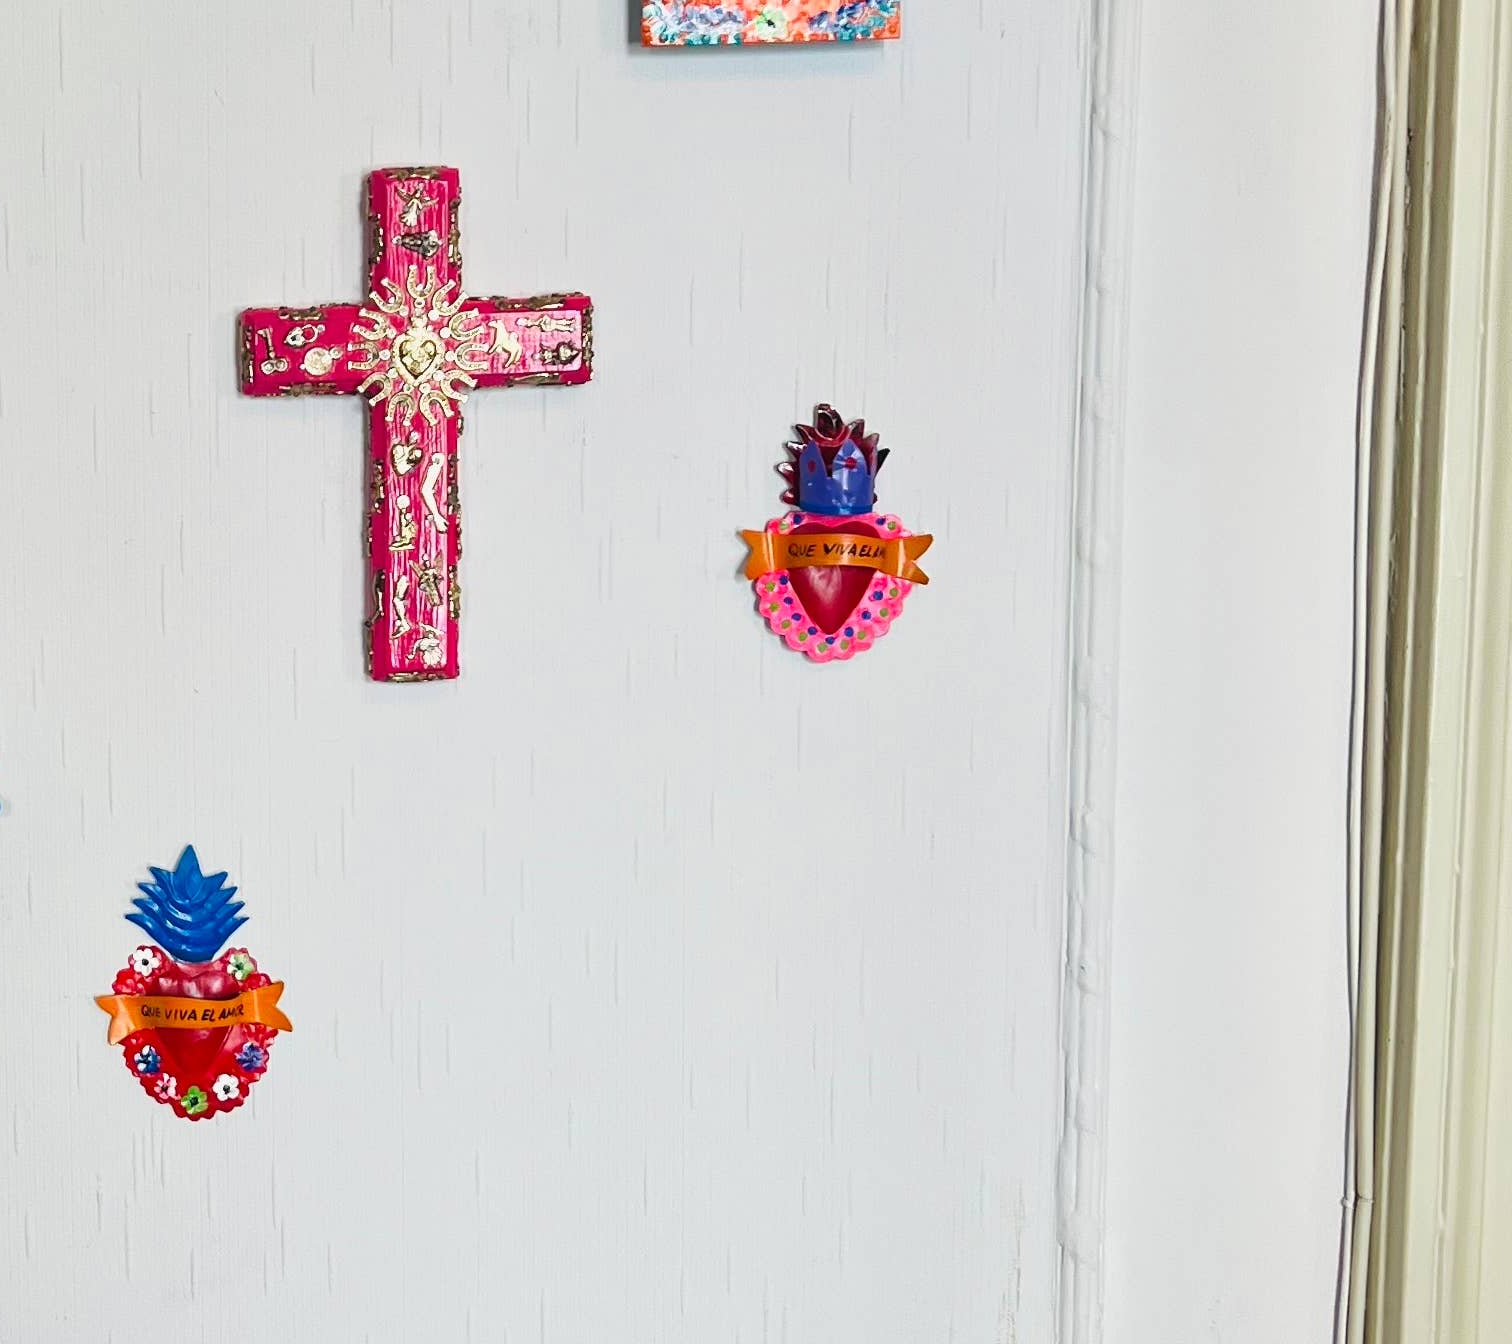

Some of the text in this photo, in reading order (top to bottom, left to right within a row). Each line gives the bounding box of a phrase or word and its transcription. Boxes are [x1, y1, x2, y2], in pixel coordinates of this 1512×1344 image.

[788, 543, 816, 557] QUE
[823, 543, 856, 557] VIVA
[141, 1004, 161, 1017] QUE
[165, 1008, 196, 1021] VIVA
[201, 1008, 215, 1021] EL
